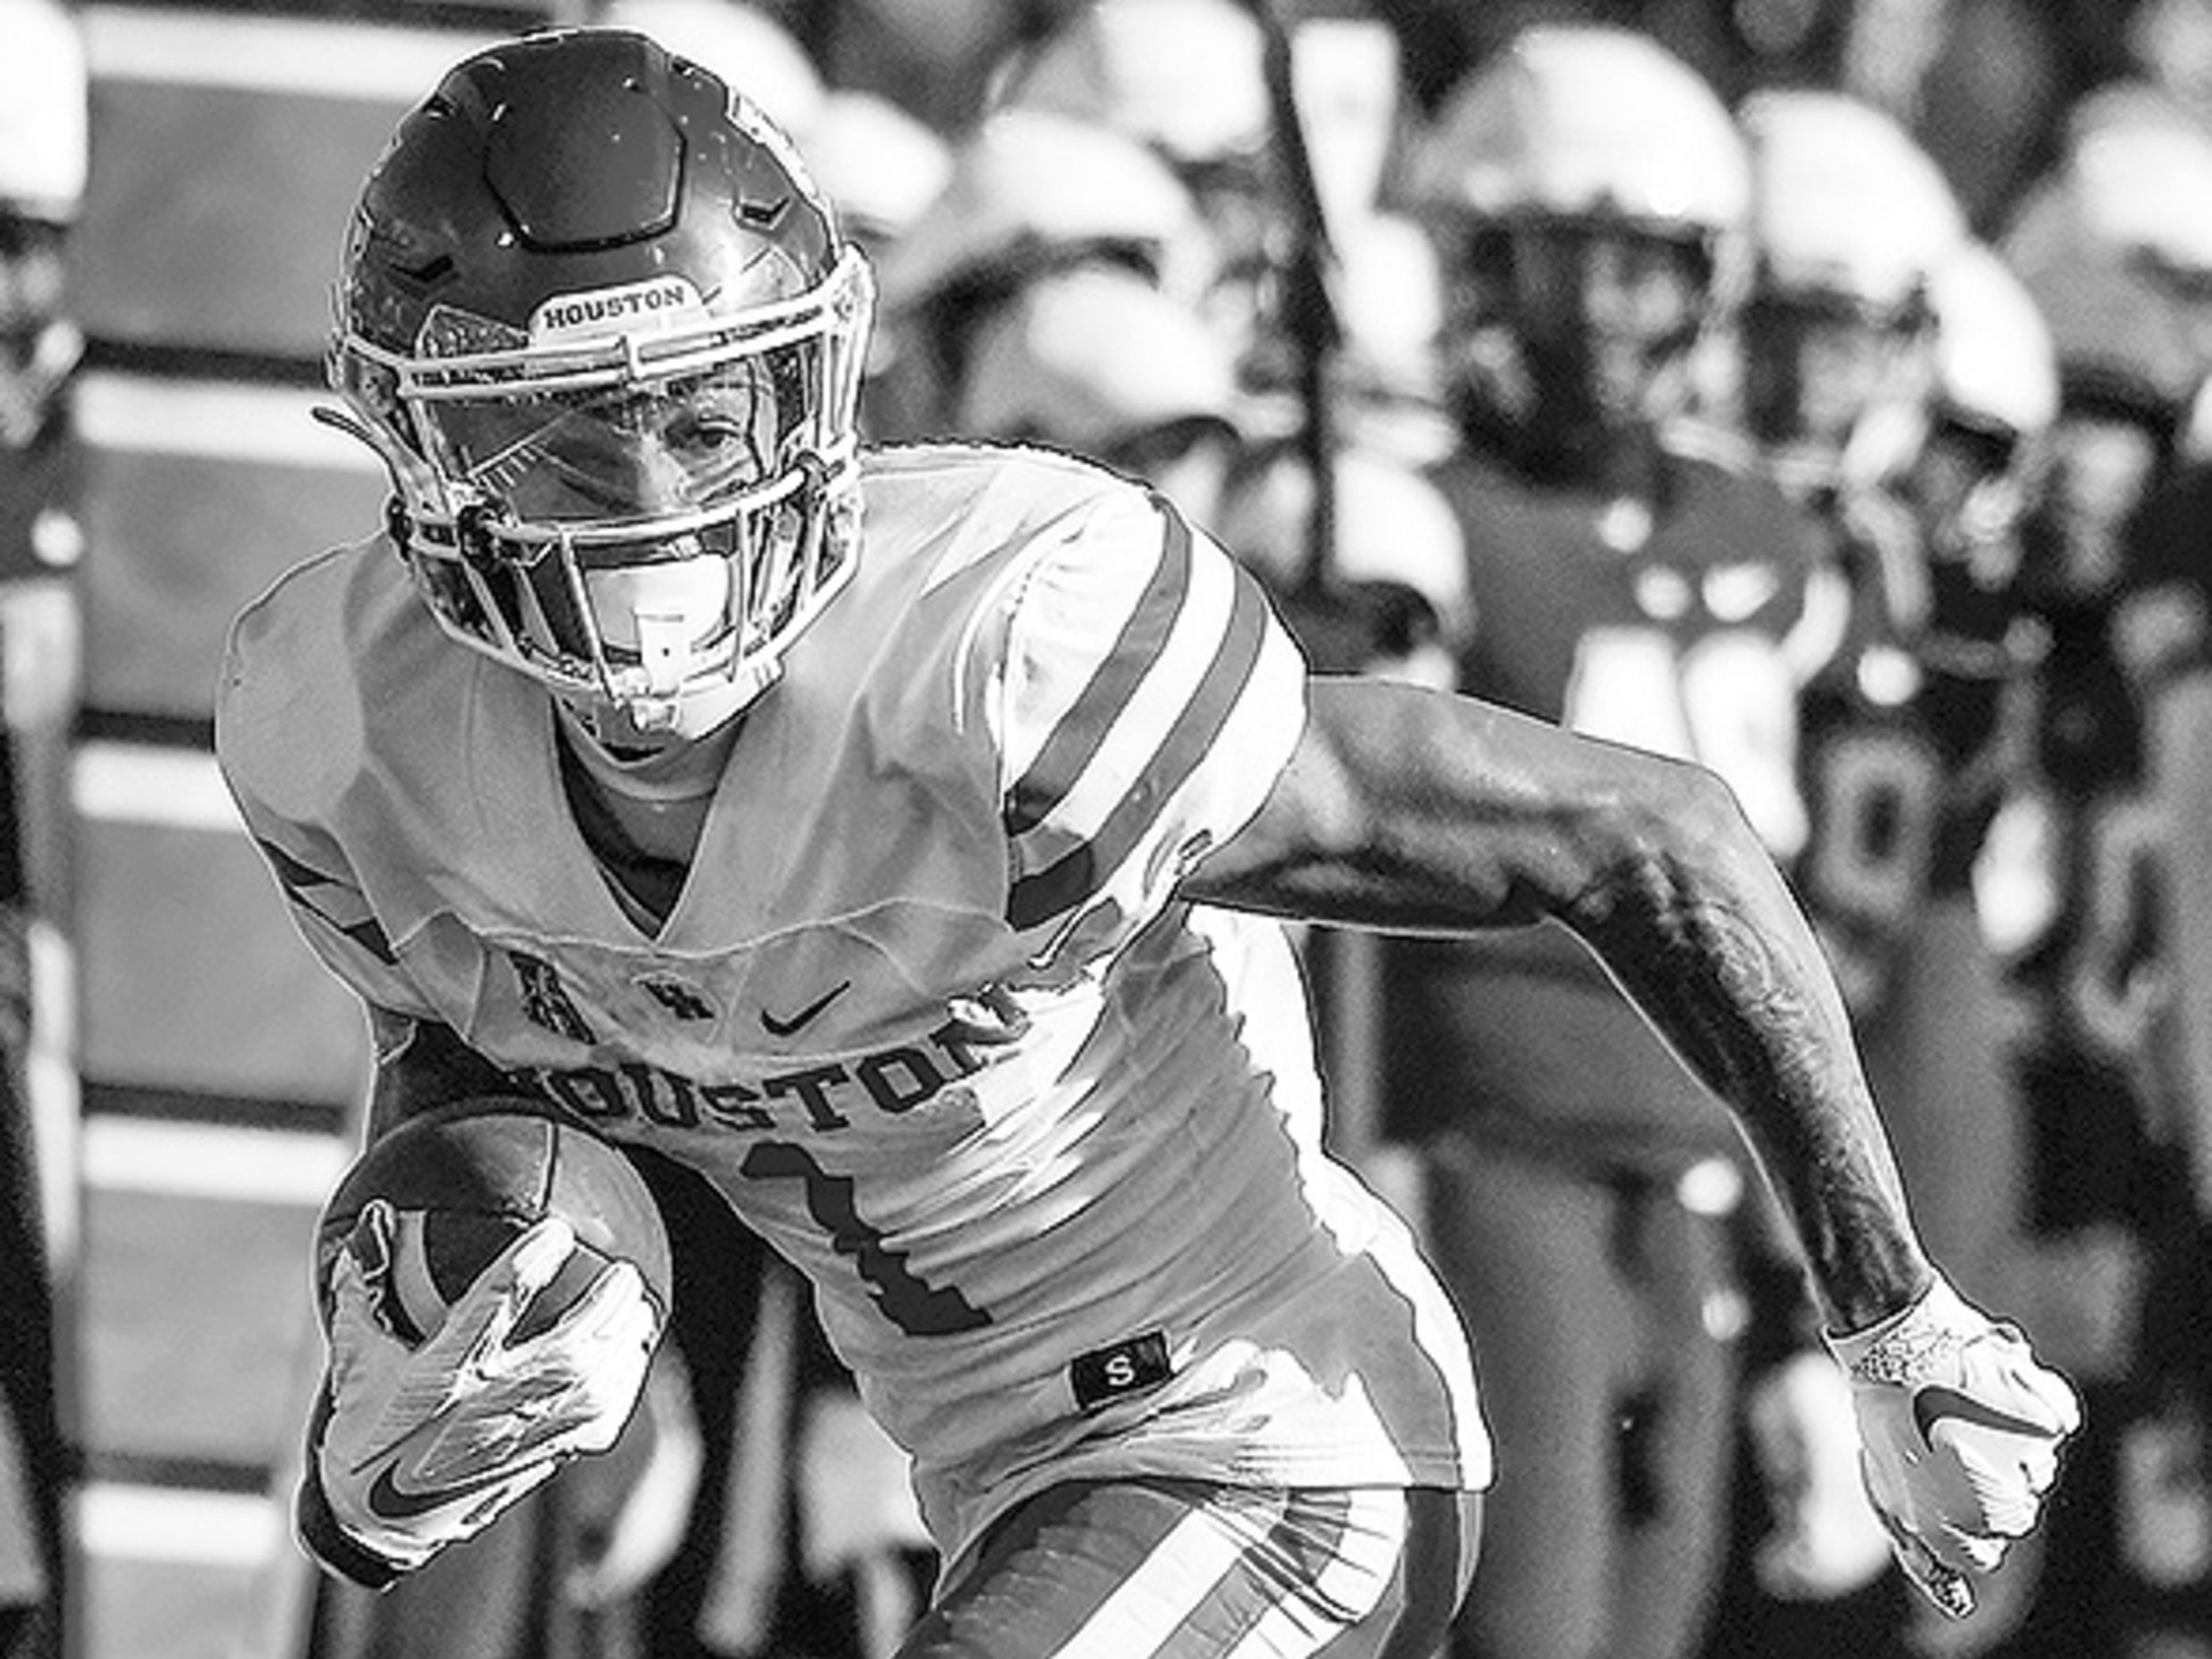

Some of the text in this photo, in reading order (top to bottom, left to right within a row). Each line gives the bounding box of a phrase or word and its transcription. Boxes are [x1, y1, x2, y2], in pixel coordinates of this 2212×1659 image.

[543, 286, 684, 328] HOUSTON
[740, 1142, 993, 1336] 1
[1105, 1355, 1135, 1385] S
